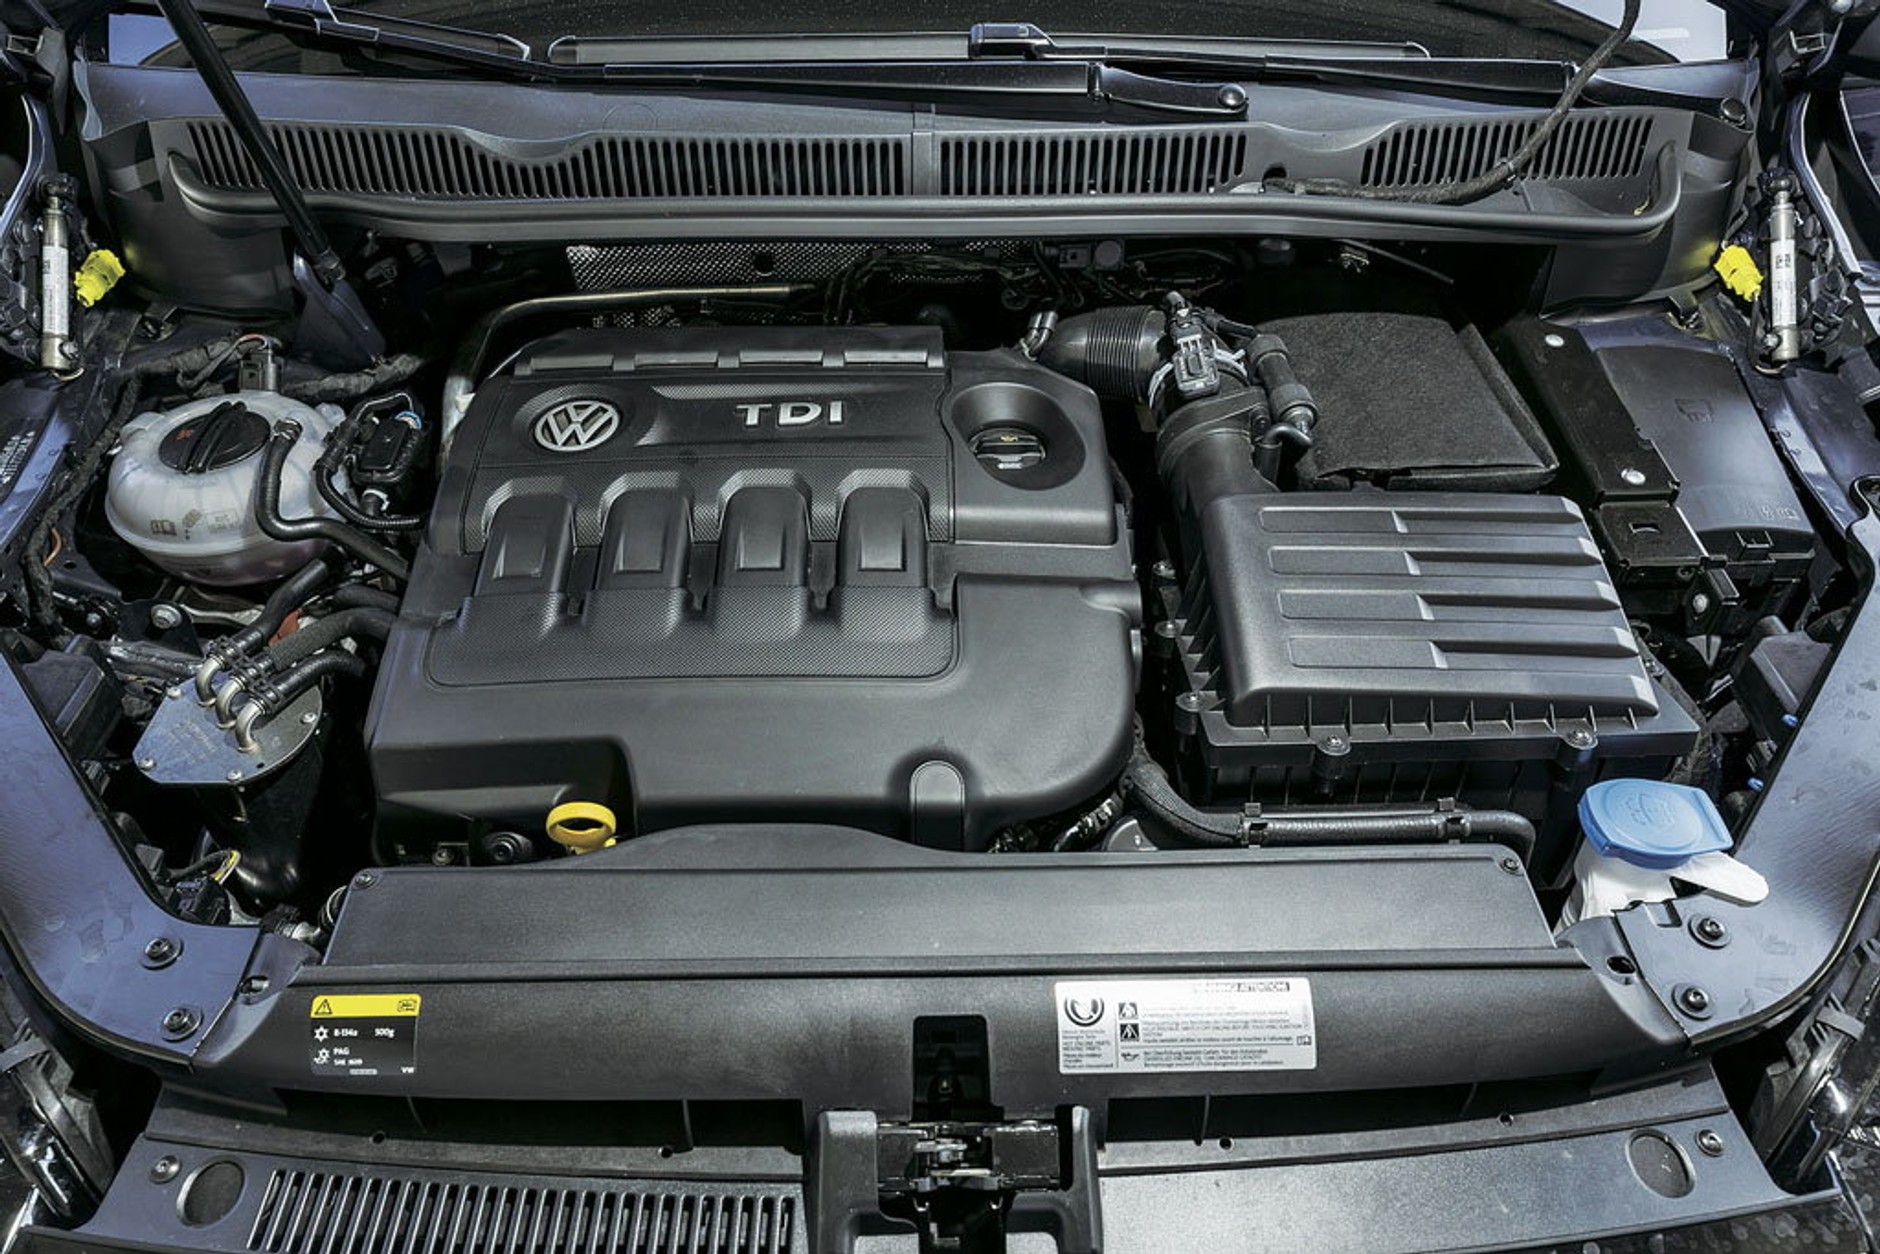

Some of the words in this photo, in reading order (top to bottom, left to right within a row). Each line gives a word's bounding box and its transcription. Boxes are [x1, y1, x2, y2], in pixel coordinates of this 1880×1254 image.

[534, 400, 620, 451] VW
[736, 400, 843, 426] TDI
[333, 1047, 350, 1056] PAG
